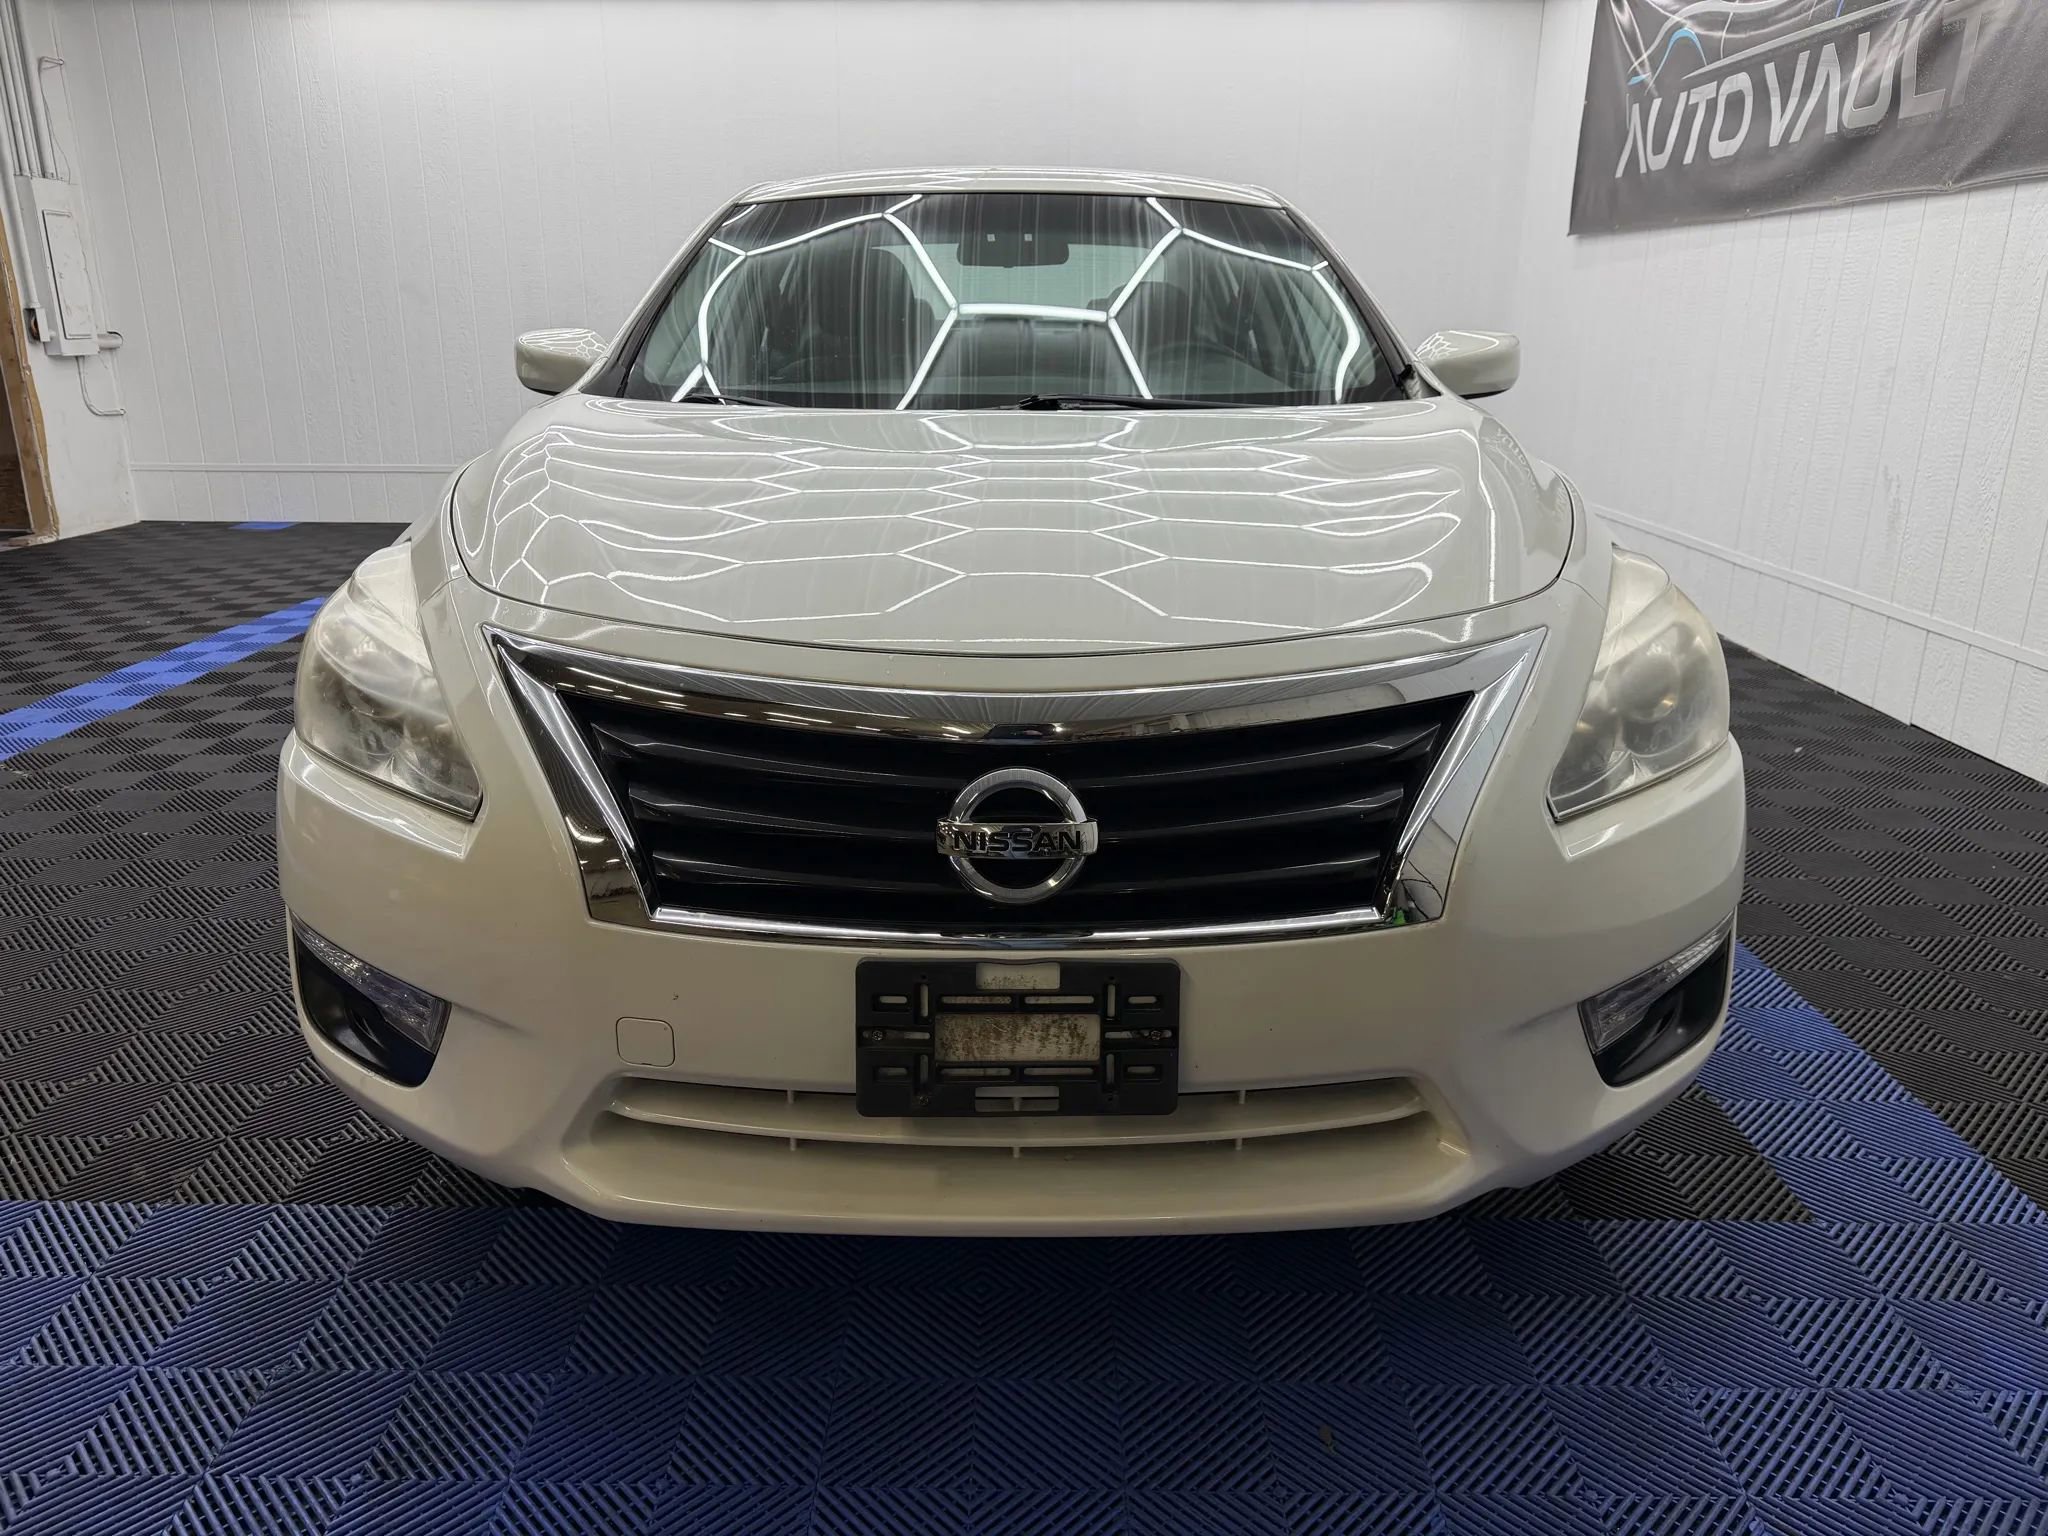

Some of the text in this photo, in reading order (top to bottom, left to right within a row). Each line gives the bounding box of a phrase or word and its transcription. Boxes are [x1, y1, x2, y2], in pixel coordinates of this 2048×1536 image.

[1615, 0, 2002, 178] AUTO VAULT
[953, 830, 1081, 852] NISSAN
